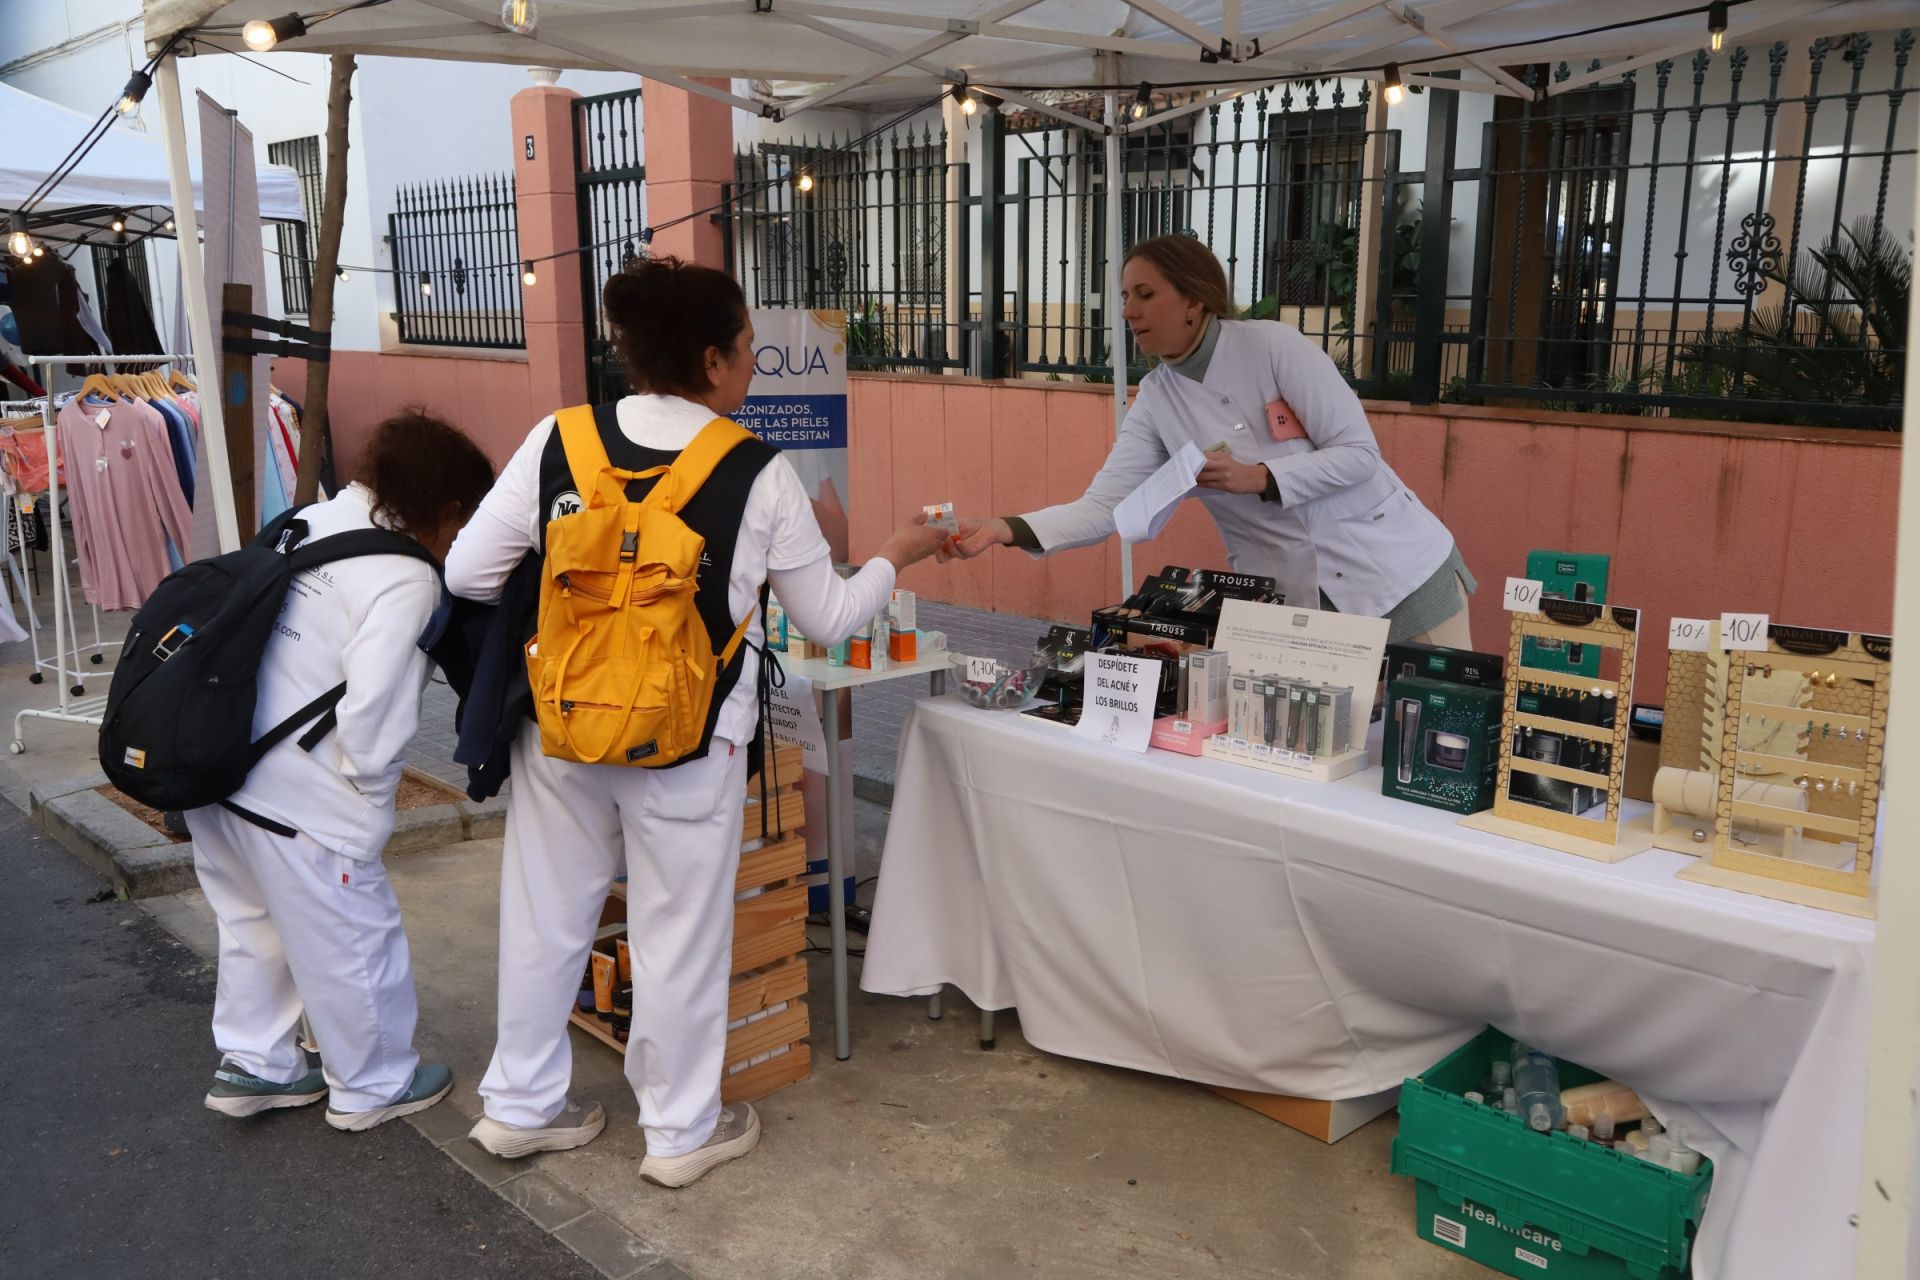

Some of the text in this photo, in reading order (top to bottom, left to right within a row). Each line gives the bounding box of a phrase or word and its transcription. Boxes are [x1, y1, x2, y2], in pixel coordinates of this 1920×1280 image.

[526, 138, 534, 158] 3
[753, 345, 829, 378] QUA
[736, 417, 829, 428] QUE LAS PIELES
[767, 430, 830, 441] NECESITAN
[1213, 574, 1256, 588] TROUSS
[1151, 623, 1186, 636] TROUSS
[1098, 657, 1139, 674] DESPÍDETE
[1464, 666, 1480, 676] 91%
[1097, 676, 1138, 693] DEL ACNÉ Y
[764, 702, 802, 717] OTECTOR
[1095, 695, 1138, 712] LOS BRILLOS
[1460, 1202, 1563, 1252] Heacare
